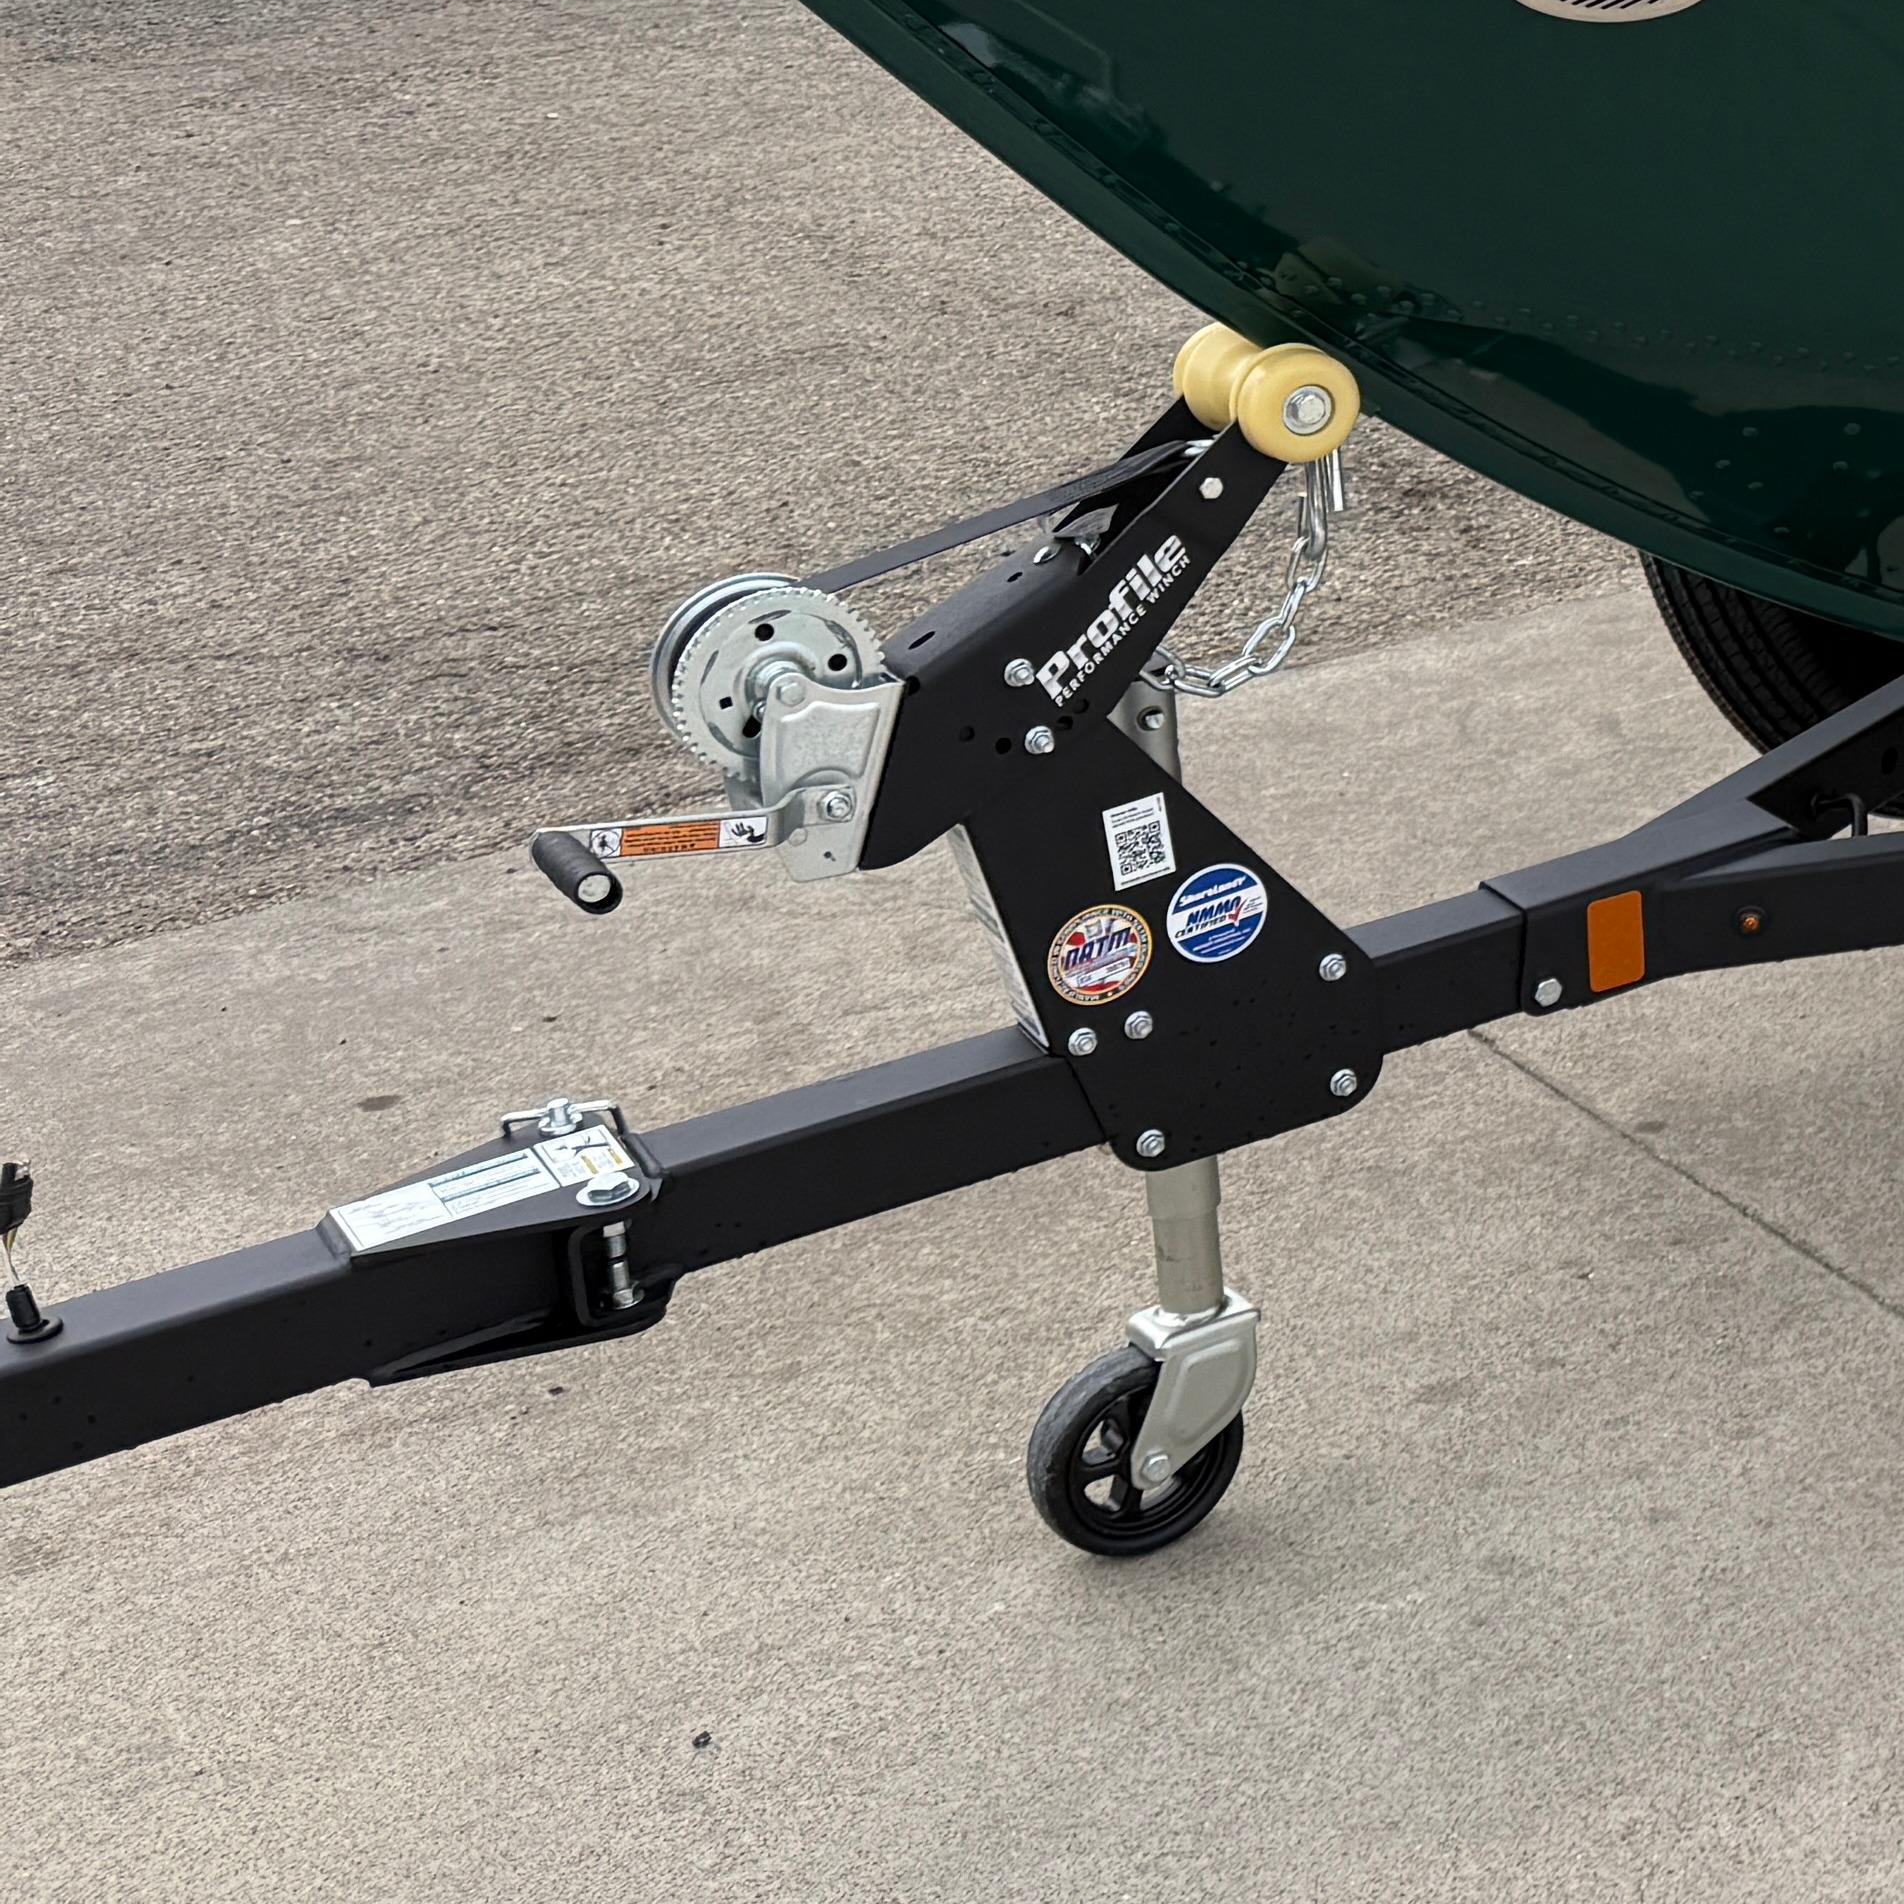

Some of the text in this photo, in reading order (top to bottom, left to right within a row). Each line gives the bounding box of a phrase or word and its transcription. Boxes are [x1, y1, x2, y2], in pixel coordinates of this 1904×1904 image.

[1035, 534, 1187, 700] Profile
[1054, 554, 1191, 708] PERFORMANCE WINCH
